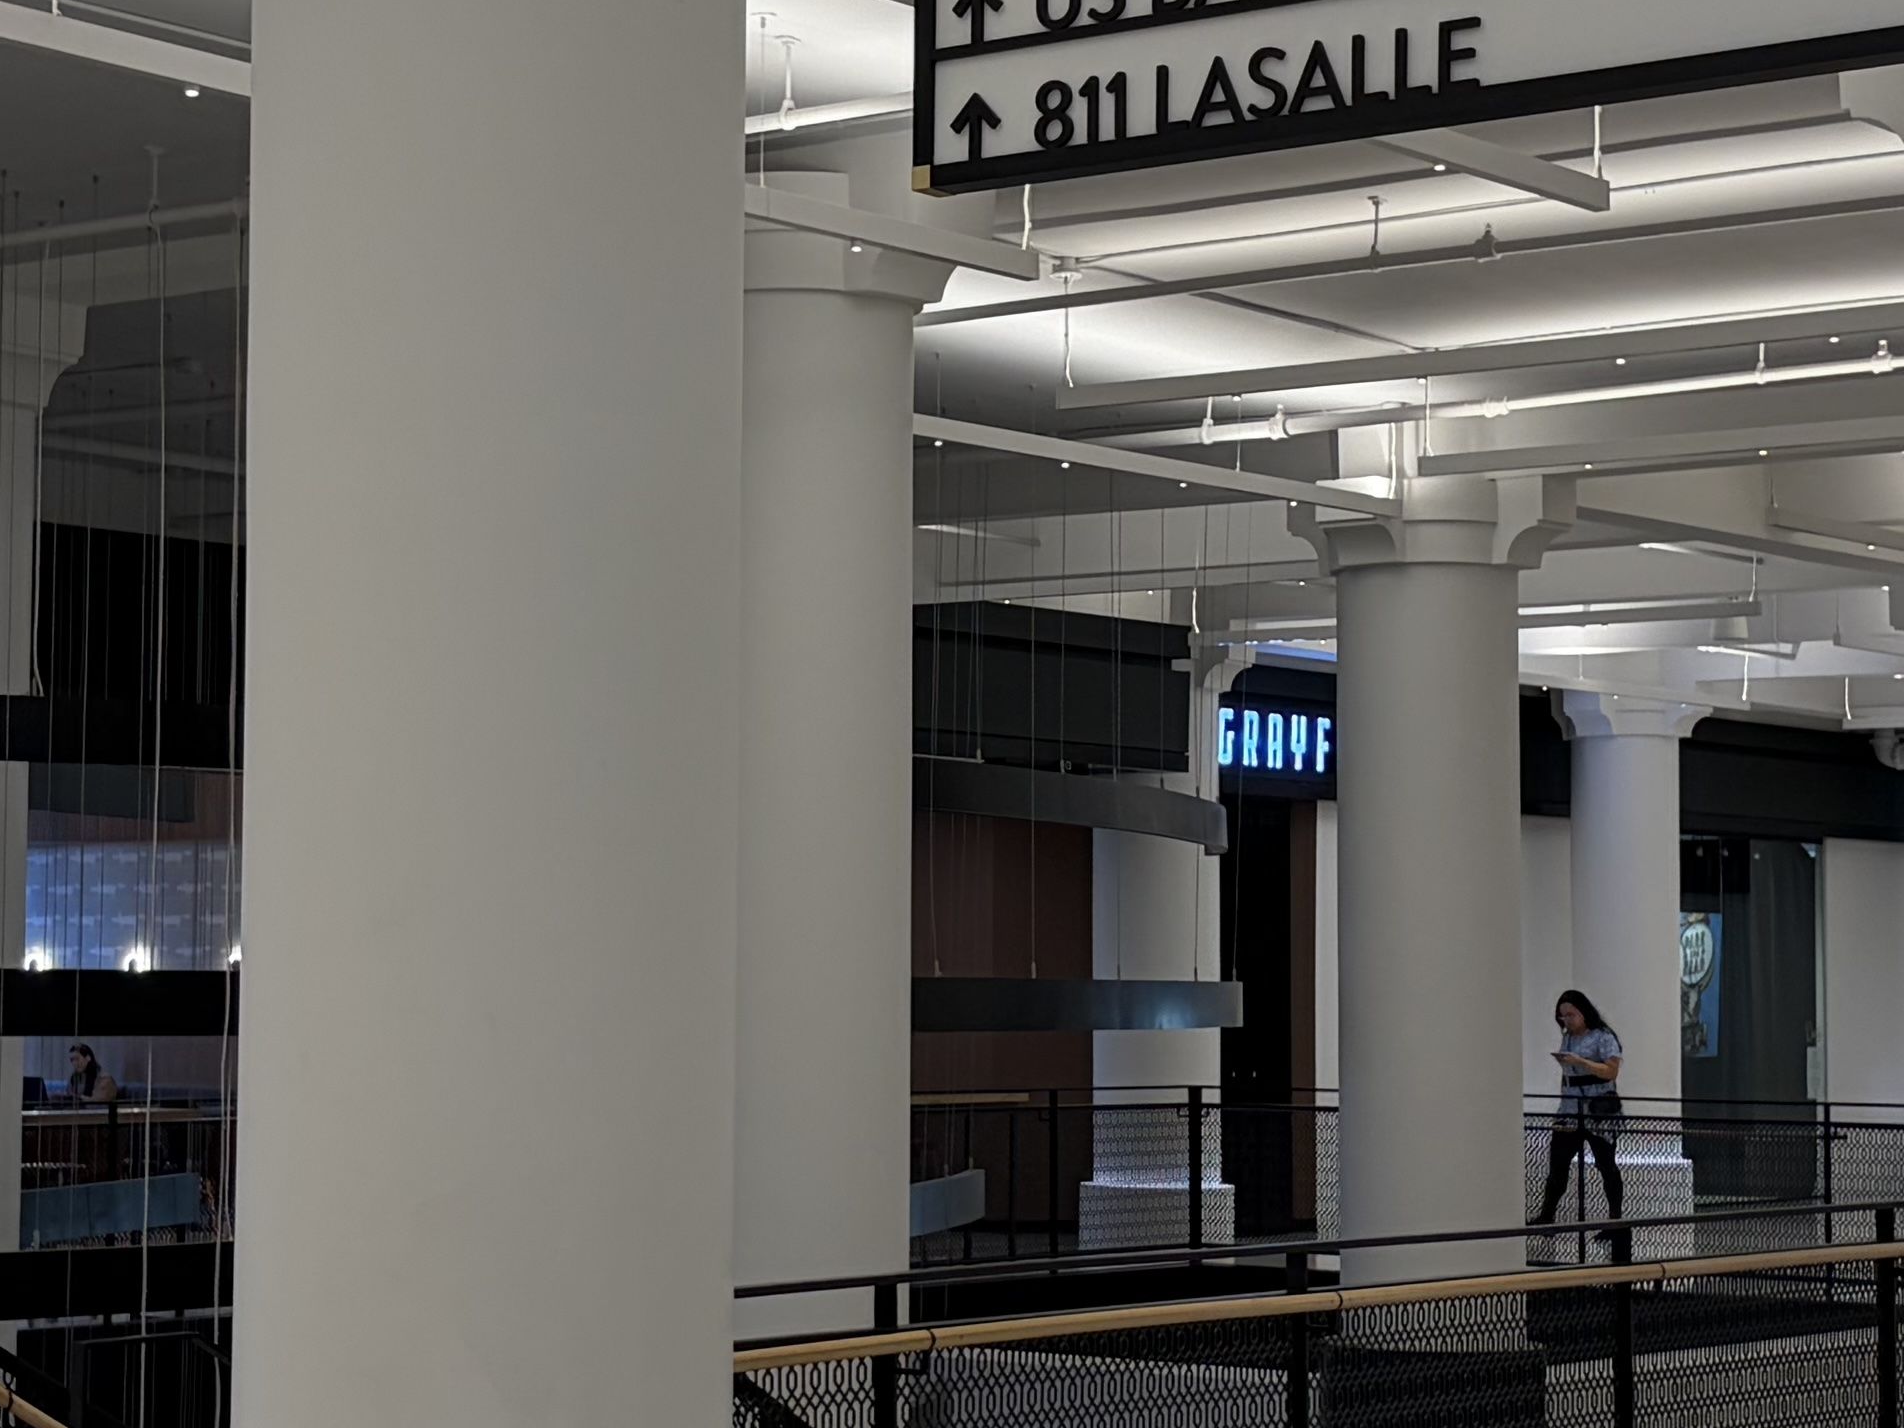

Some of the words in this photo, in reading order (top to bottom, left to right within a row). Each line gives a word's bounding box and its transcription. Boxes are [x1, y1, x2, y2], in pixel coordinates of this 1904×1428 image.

[1034, 71, 1128, 149] 811
[1156, 16, 1482, 135] LASALLE
[1218, 707, 1331, 773] GRAYF
